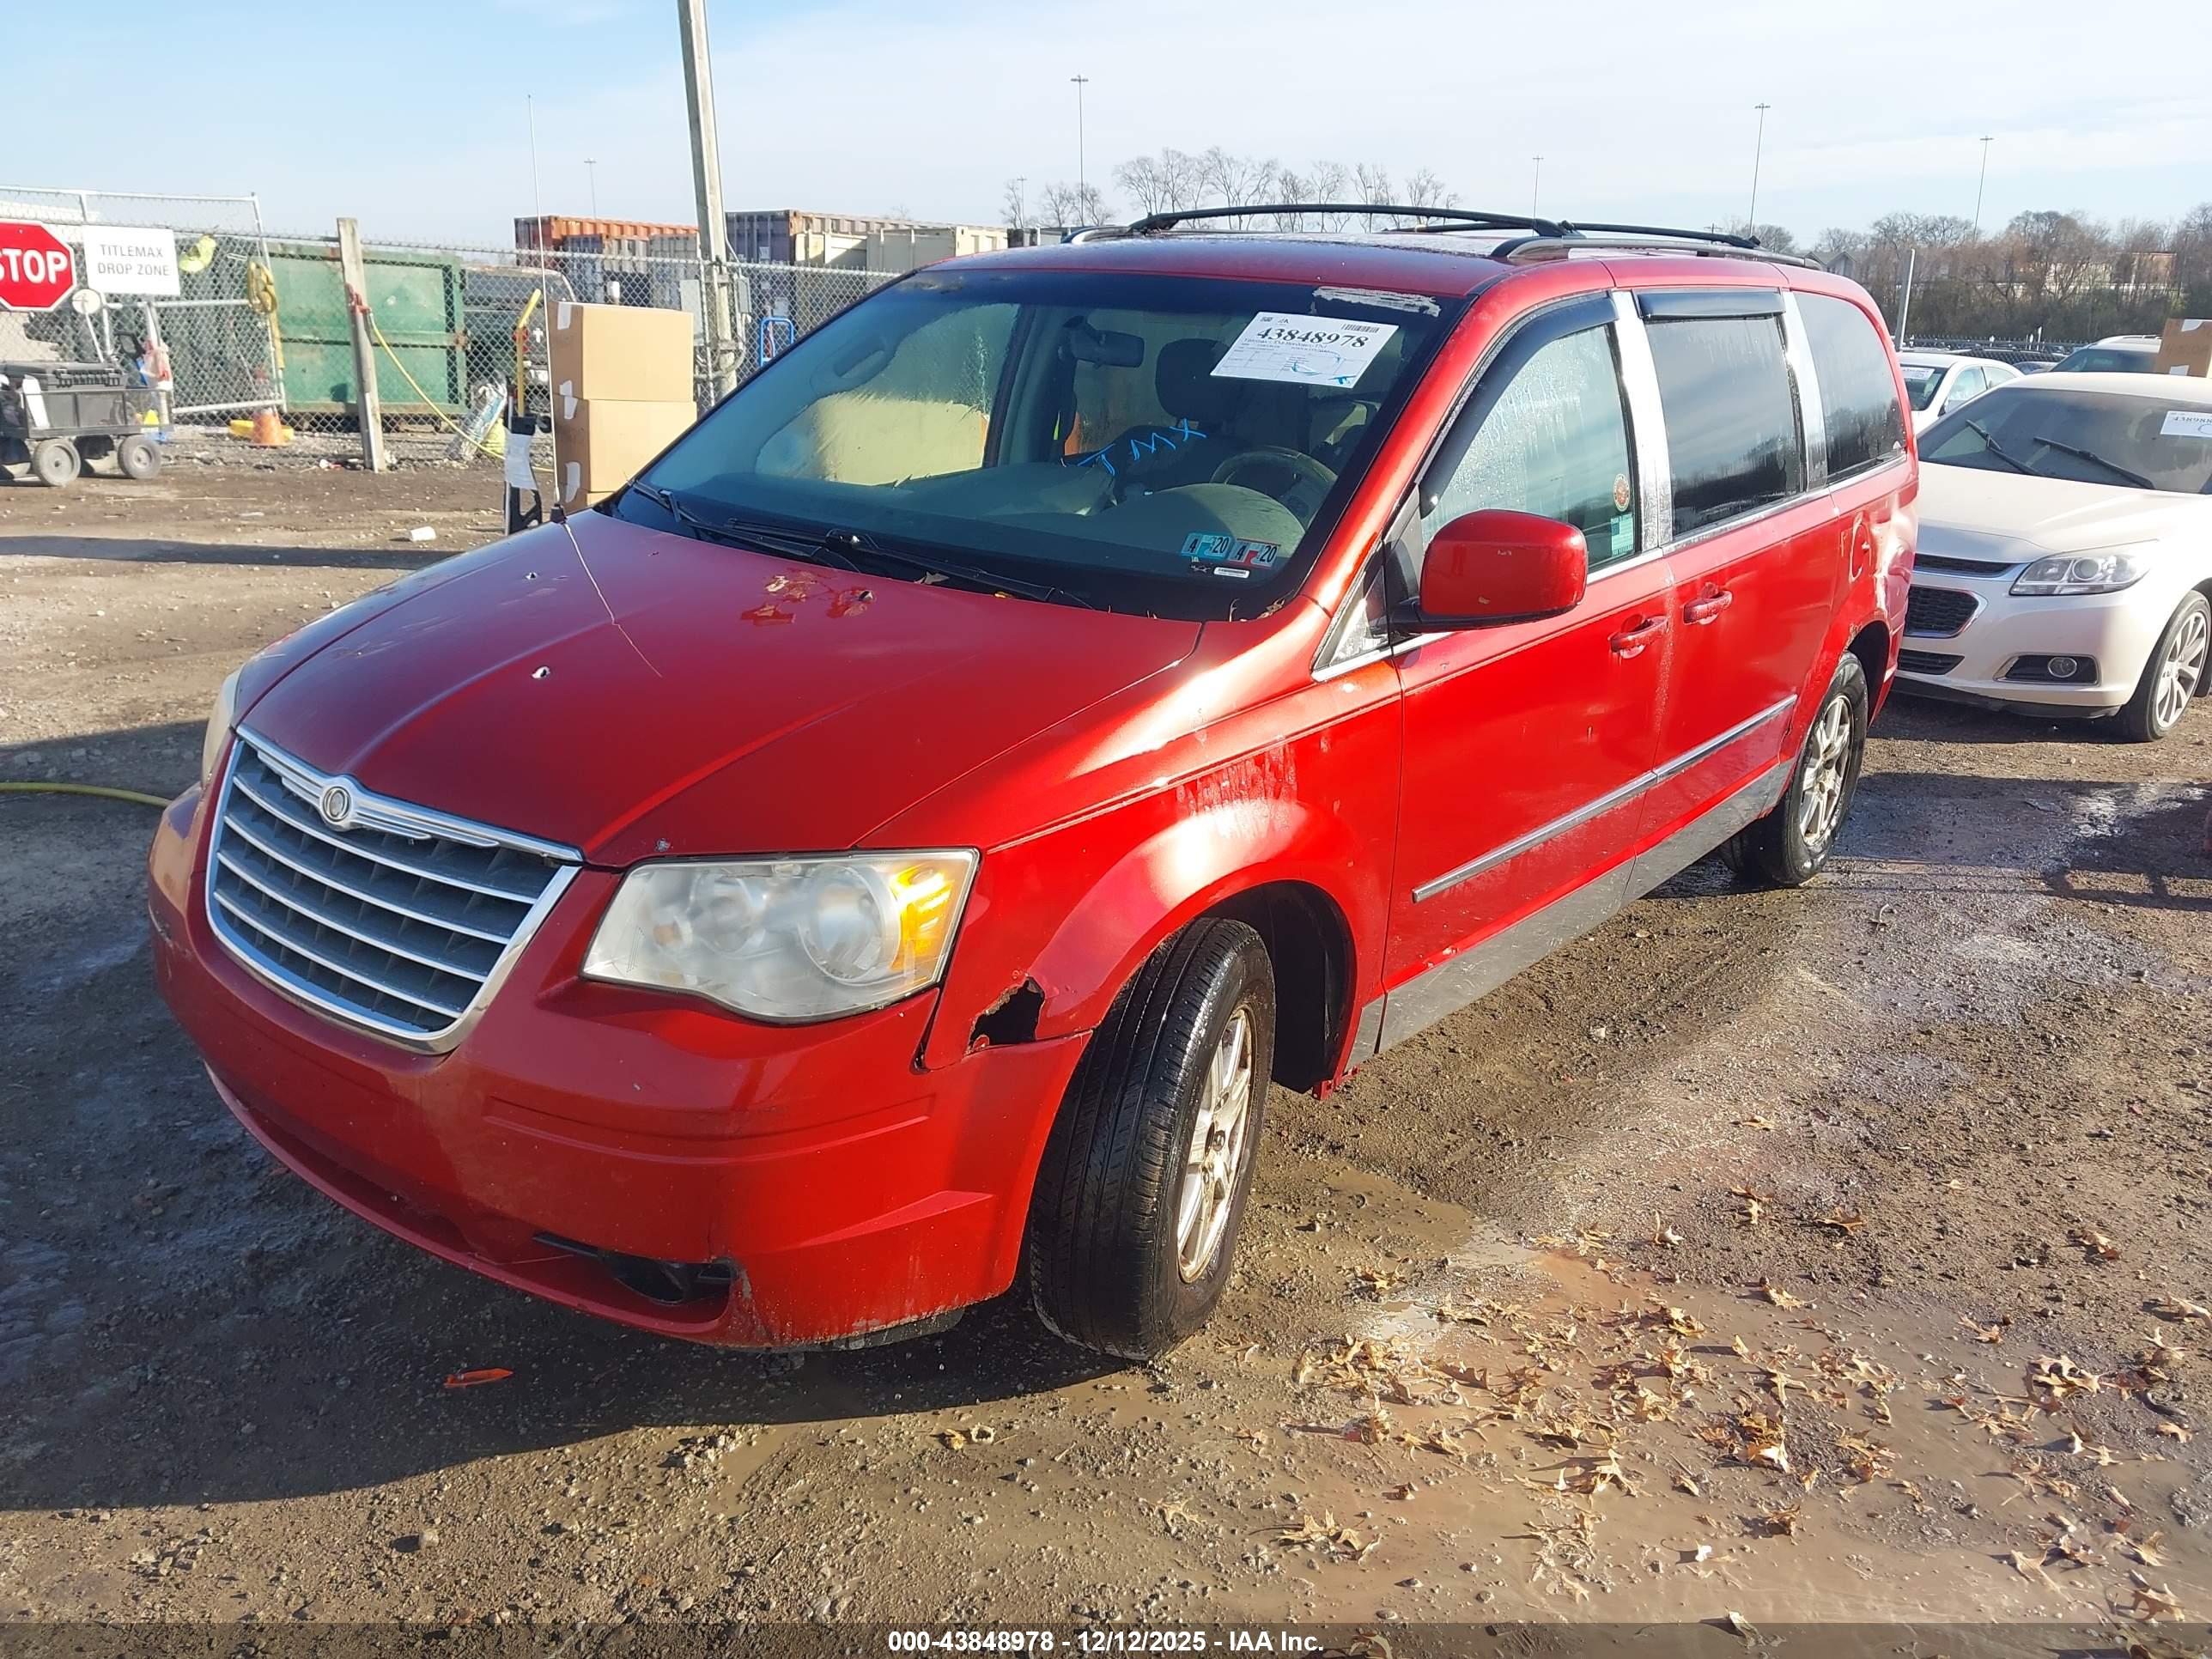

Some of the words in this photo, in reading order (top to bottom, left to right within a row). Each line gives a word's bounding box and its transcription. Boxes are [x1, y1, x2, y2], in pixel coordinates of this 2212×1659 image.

[100, 244, 164, 259] TITLEMAX
[97, 262, 133, 275] DROP
[137, 264, 171, 276] ZONE
[1257, 326, 1370, 349] 43848978
[1188, 538, 1199, 554] 4
[1213, 537, 1230, 554] 20
[1235, 545, 1247, 561] 4
[1260, 544, 1279, 562] 20
